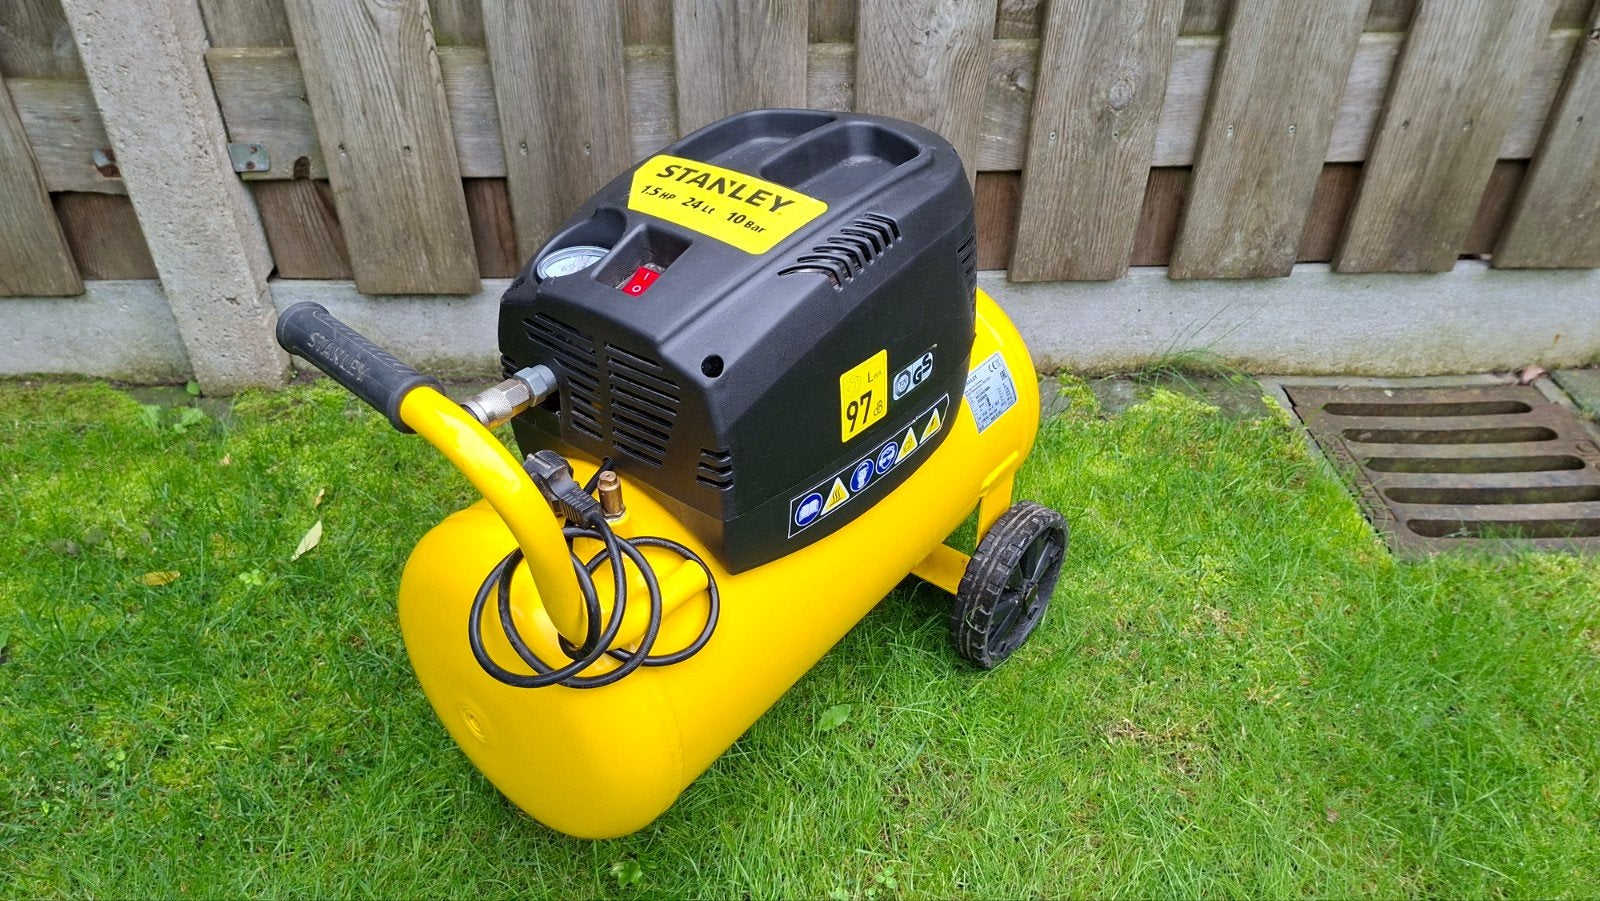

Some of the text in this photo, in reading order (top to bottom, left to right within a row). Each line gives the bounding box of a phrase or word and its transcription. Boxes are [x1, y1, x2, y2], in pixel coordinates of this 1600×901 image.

[641, 185, 767, 234] 1.5 HP 24 Lt 10 Bar
[656, 164, 796, 213] STANLEY
[307, 331, 370, 382] STANLEY
[913, 352, 933, 385] GS
[846, 390, 873, 433] 97
